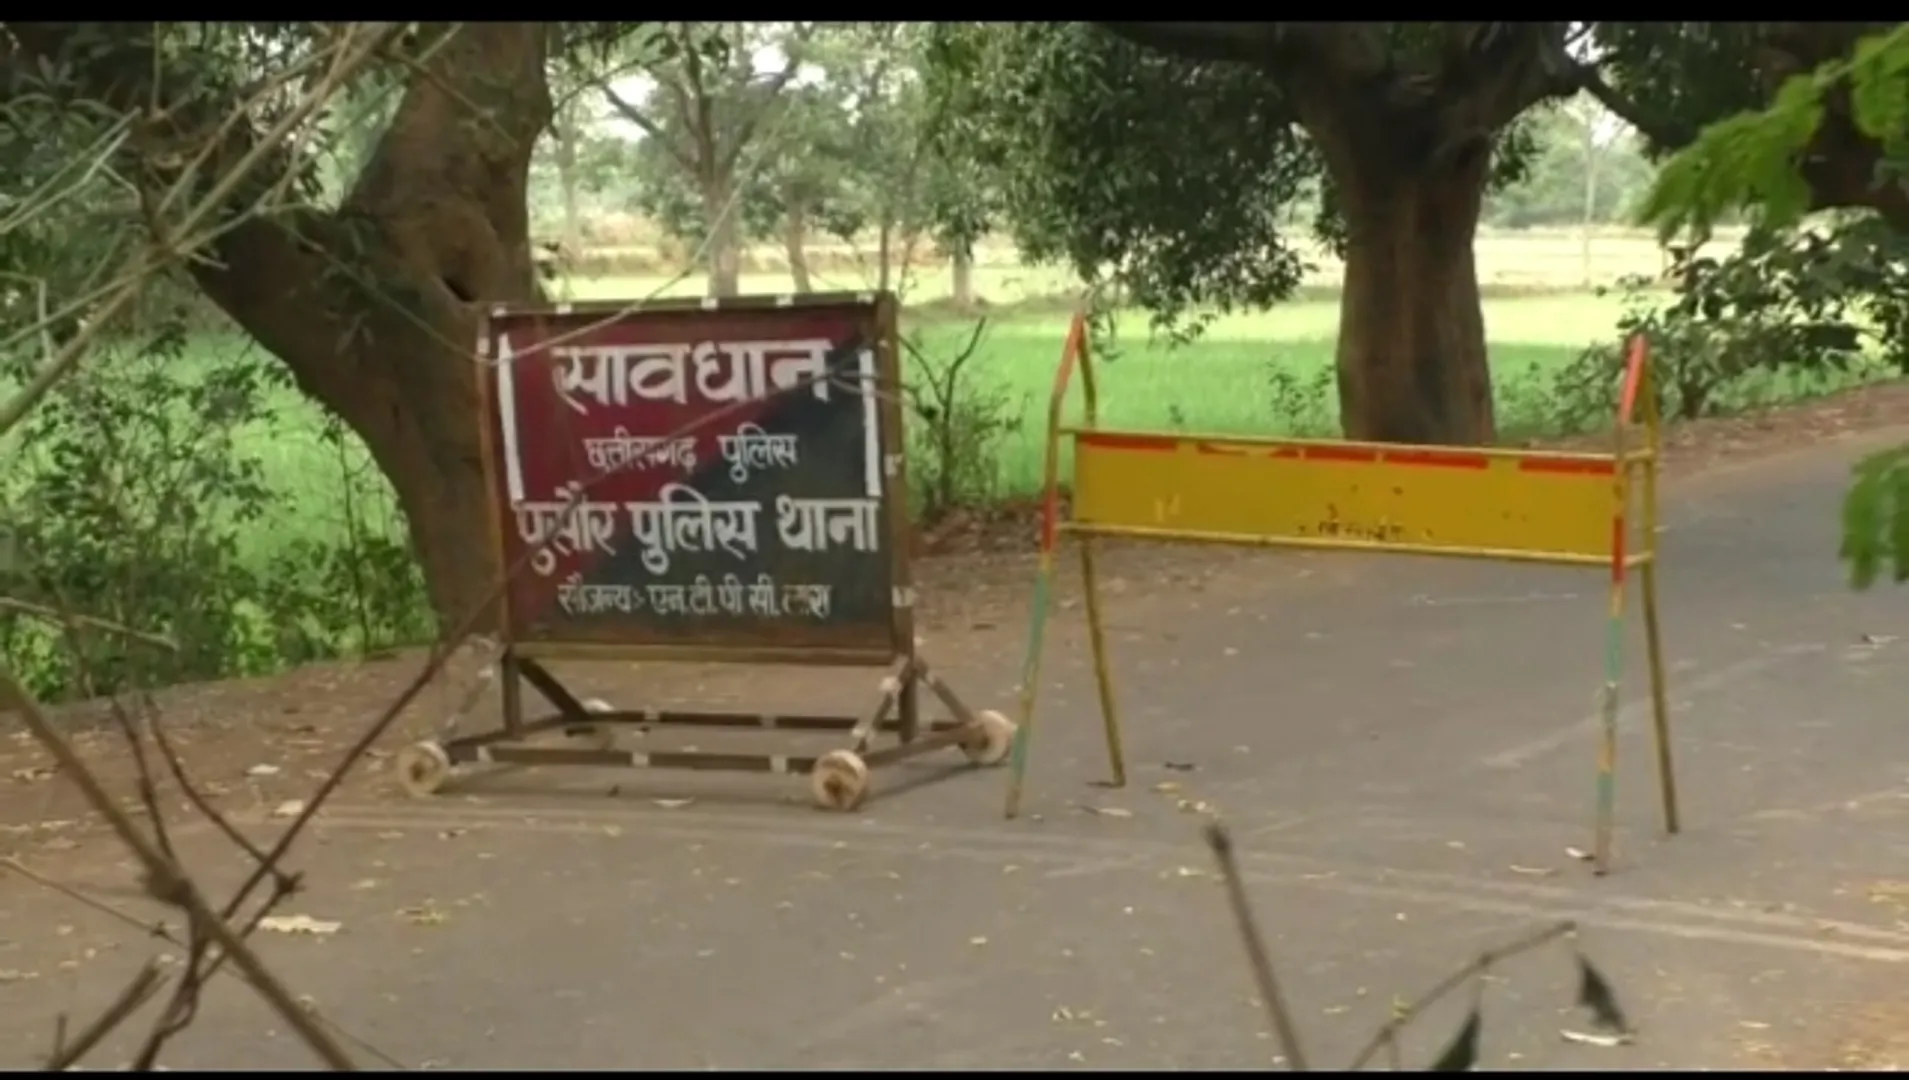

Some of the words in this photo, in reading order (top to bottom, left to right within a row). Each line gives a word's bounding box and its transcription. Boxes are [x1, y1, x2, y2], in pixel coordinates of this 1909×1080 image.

[552, 340, 832, 415] सावधान
[716, 422, 798, 483] पुलिस
[513, 481, 617, 574] पुसौर
[626, 483, 762, 574] पुलिस
[776, 495, 880, 551] थाना
